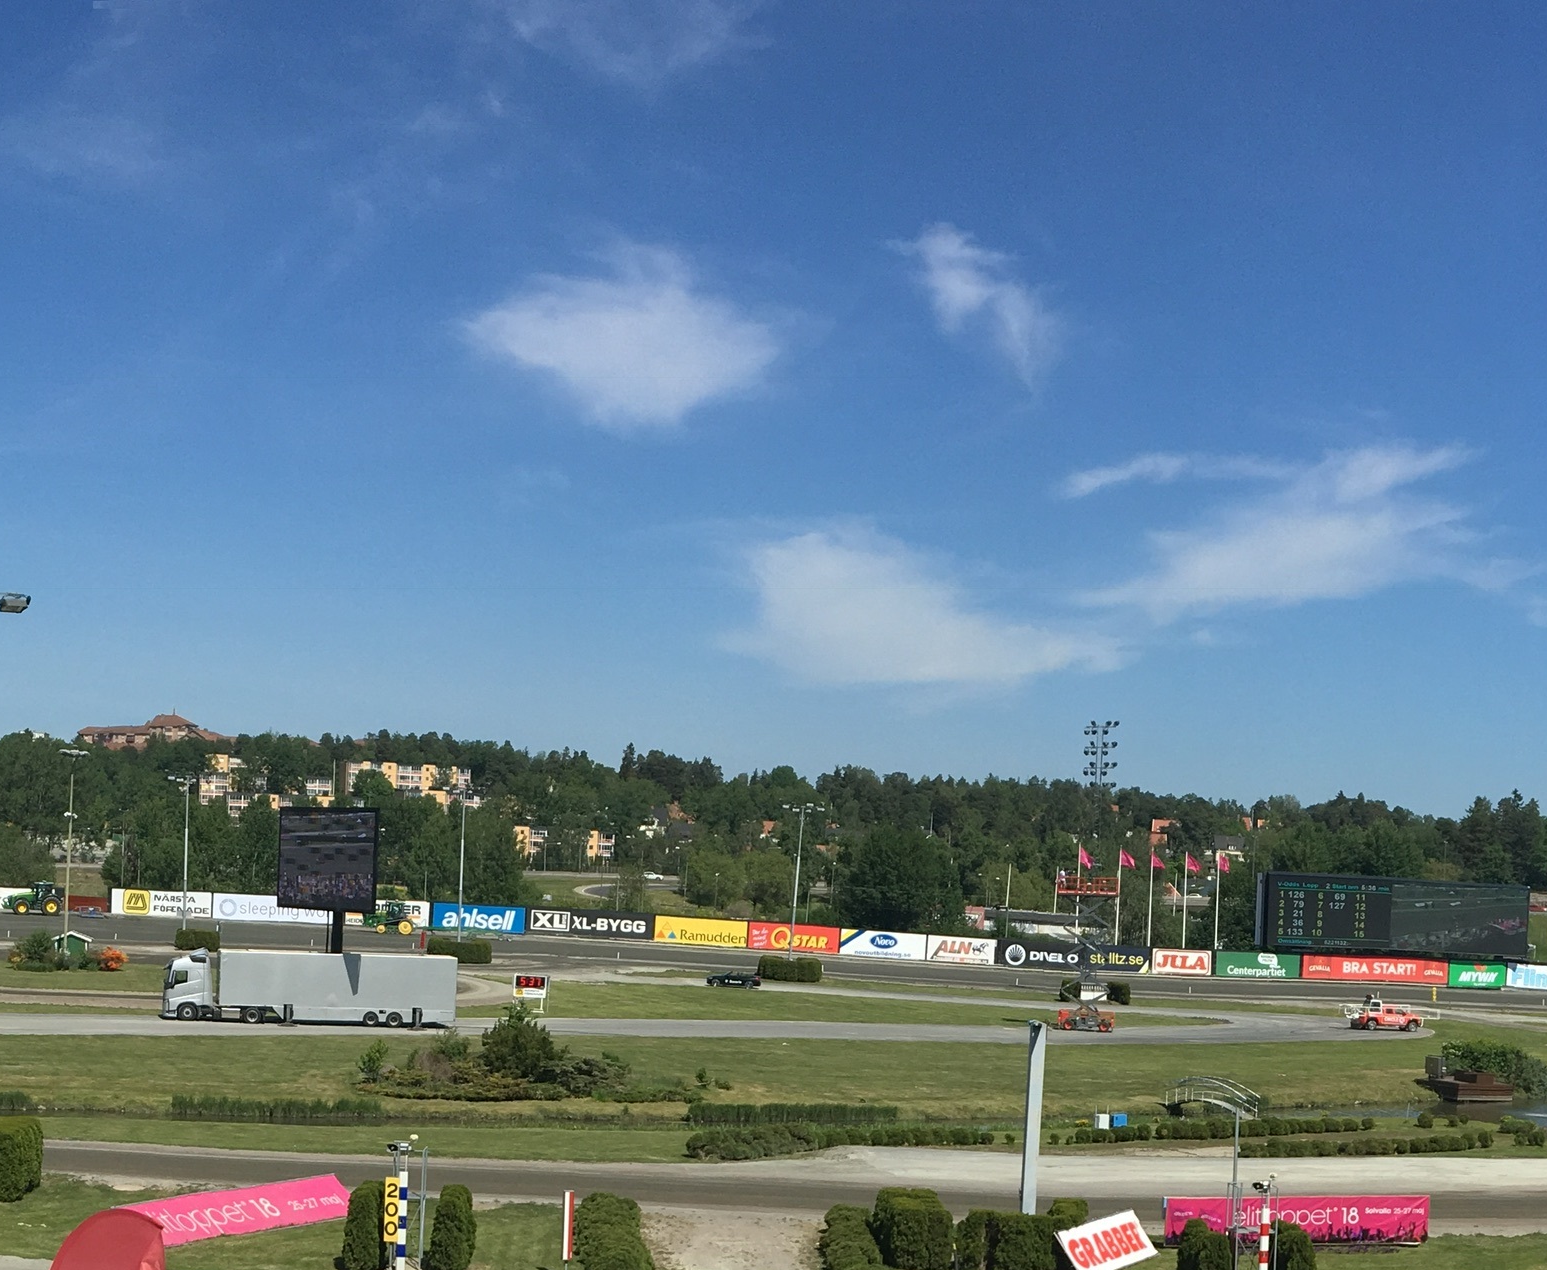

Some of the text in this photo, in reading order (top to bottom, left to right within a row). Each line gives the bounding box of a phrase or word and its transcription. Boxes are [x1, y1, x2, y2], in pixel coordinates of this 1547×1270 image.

[154, 893, 196, 903] NÄRSTA
[1288, 891, 1304, 899] 126
[239, 901, 299, 919] sleeping
[1329, 902, 1345, 910] 127
[442, 907, 516, 930] ahlsell
[572, 915, 646, 933] XL-BYGG
[680, 929, 747, 944] Ramudden
[935, 939, 972, 955] ALN
[1157, 954, 1207, 971] JULA
[1309, 964, 1331, 972] GEVALIA
[1342, 961, 1417, 976] BRA START!
[1227, 965, 1286, 978] Centerpartiet
[250, 1197, 281, 1218] 18
[287, 1197, 319, 1211] 25-27
[320, 1193, 344, 1207] maj
[385, 1183, 399, 1236] 200
[1342, 1206, 1359, 1224] 18
[1365, 1207, 1391, 1215] Solvalla
[1412, 1207, 1425, 1216] maj
